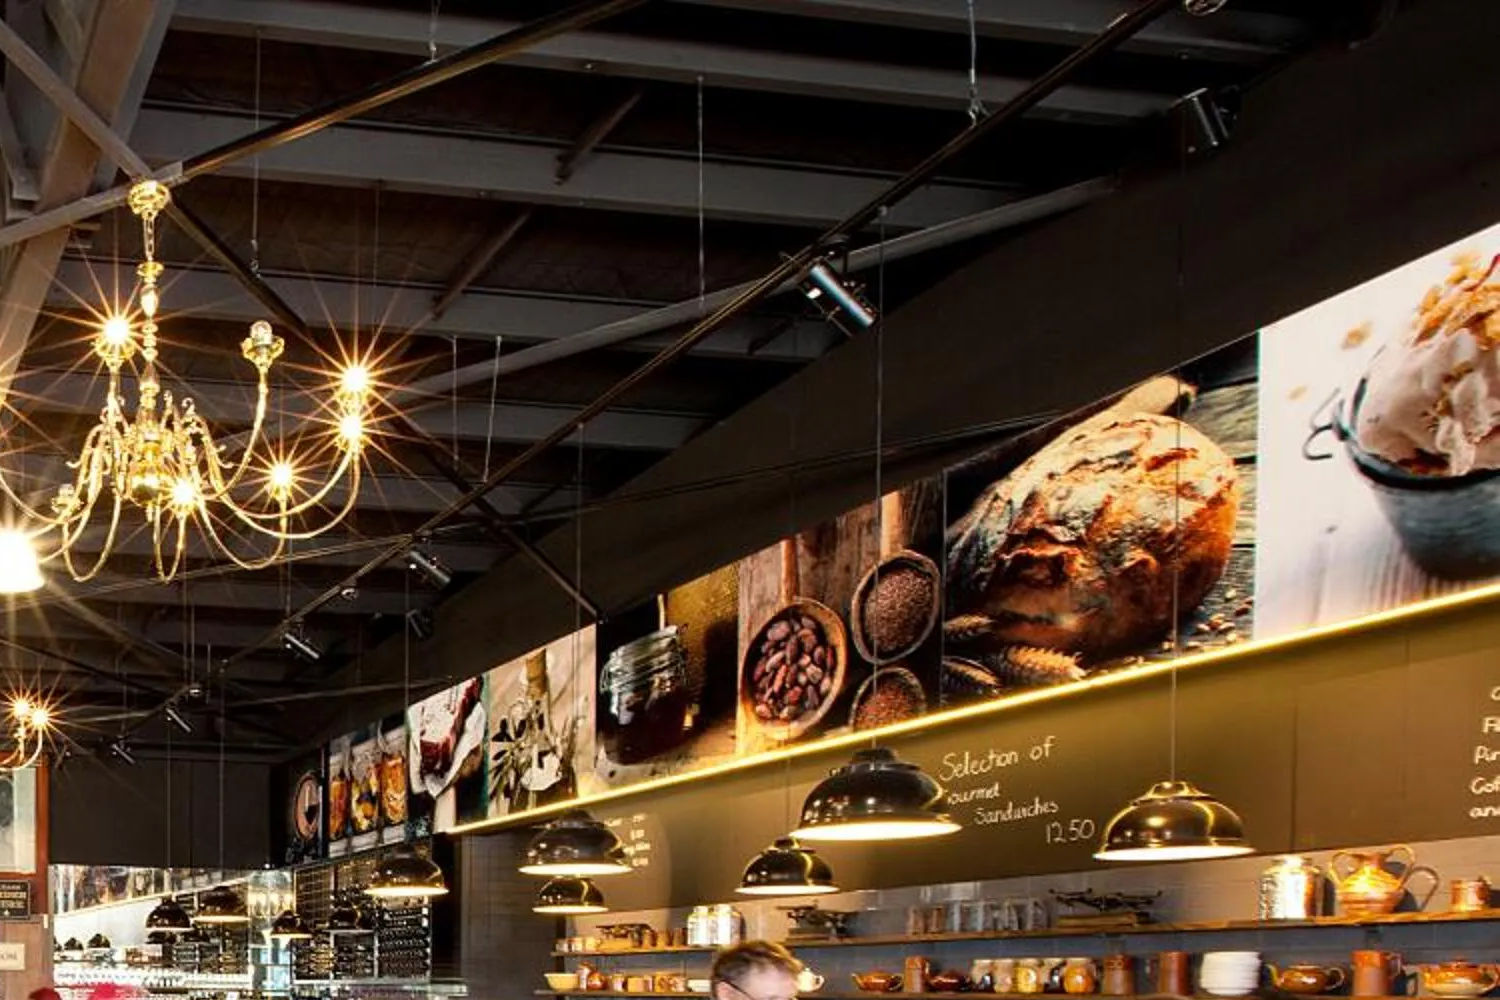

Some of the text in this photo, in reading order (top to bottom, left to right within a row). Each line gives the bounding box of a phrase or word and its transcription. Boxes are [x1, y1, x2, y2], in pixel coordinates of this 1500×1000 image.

[940, 735, 1055, 781] Selection of
[944, 782, 1000, 805] ourmet
[973, 796, 1060, 825] Sandwiches
